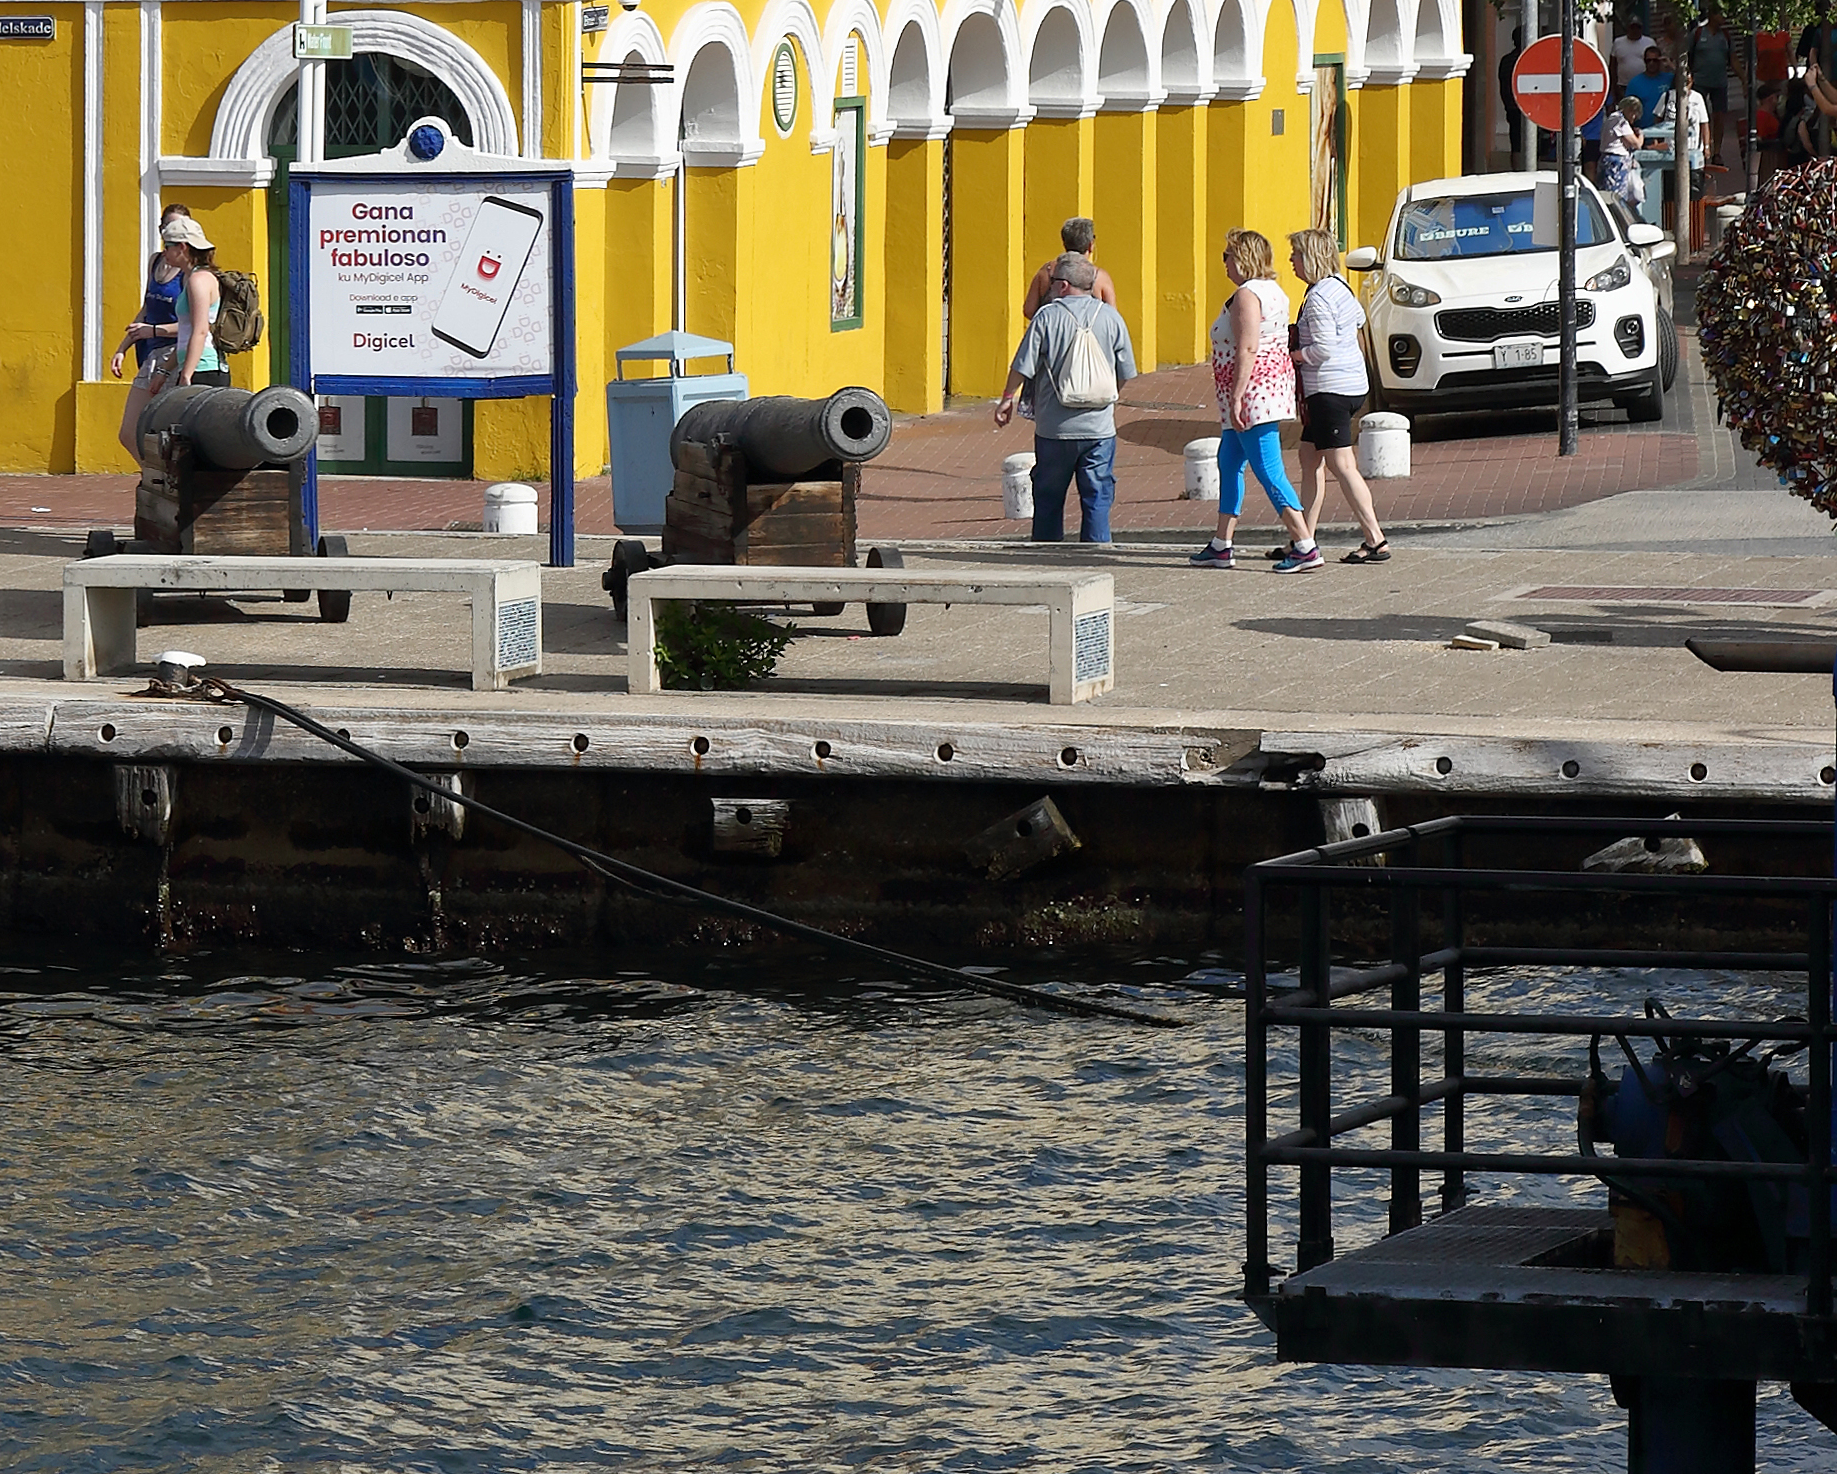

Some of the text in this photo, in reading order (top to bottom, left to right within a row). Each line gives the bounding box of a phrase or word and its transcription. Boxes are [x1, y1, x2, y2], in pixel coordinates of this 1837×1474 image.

[352, 203, 414, 220] Gana
[320, 224, 447, 249] premionan
[331, 248, 430, 267] fabuloso
[338, 272, 429, 284] ku MyDigicel App
[349, 294, 392, 302] Download
[401, 295, 419, 303] app
[353, 333, 415, 352] Digicel
[1501, 350, 1507, 362] Y
